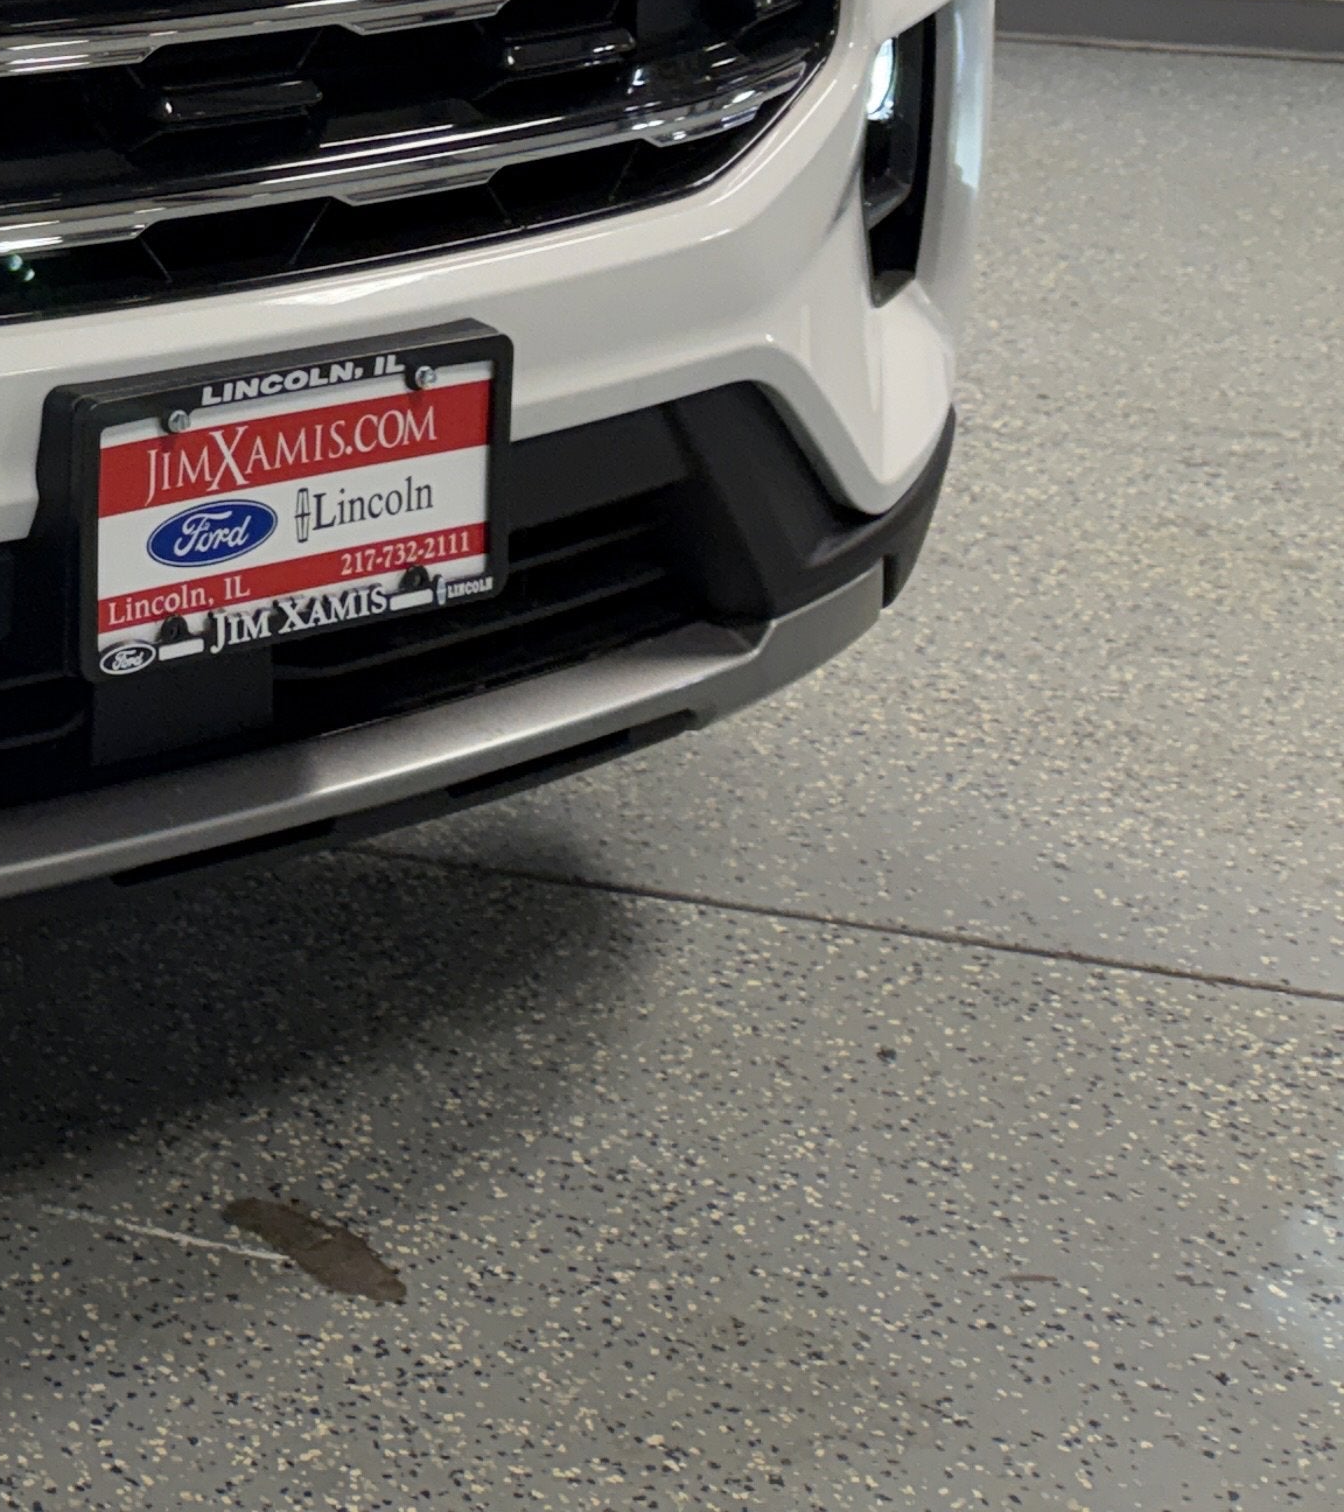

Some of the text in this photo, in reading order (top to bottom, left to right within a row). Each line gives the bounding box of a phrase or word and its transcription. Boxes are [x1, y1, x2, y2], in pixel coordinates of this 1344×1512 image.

[201, 354, 405, 407] LINCOLN, IL
[312, 476, 434, 531] Lincoln
[173, 510, 250, 557] Ford
[340, 531, 470, 576] 217-732-2111
[108, 575, 251, 626] Lincoln, IL
[209, 587, 388, 654] JIM XAMIS
[112, 649, 145, 672] Ford
